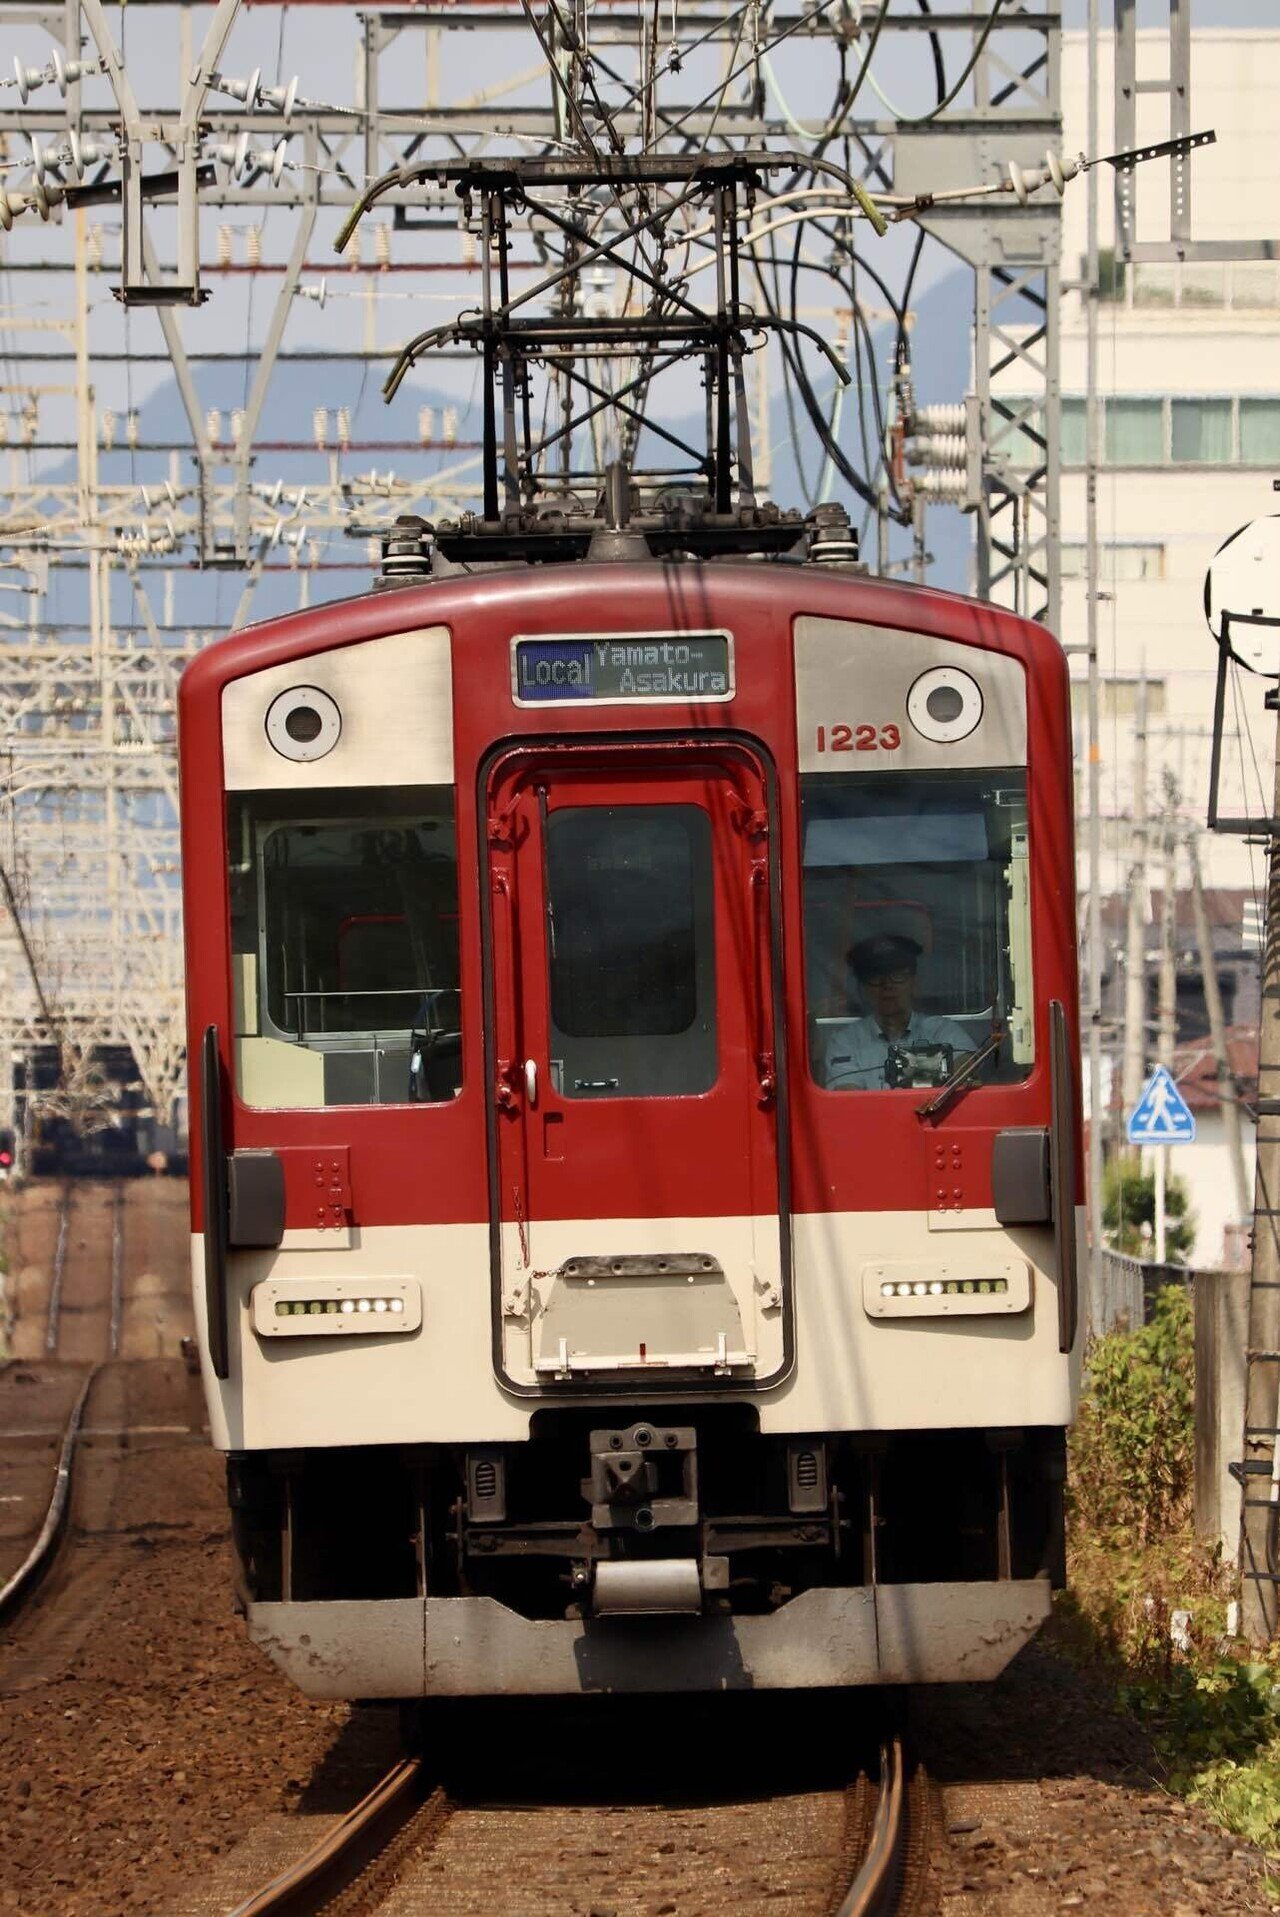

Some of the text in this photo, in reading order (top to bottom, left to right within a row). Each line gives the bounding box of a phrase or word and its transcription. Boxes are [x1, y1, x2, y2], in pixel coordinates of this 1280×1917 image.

[595, 641, 704, 667] Yamato-
[521, 653, 590, 686] Local
[619, 667, 726, 693] Asakura
[817, 724, 901, 752] 1223
